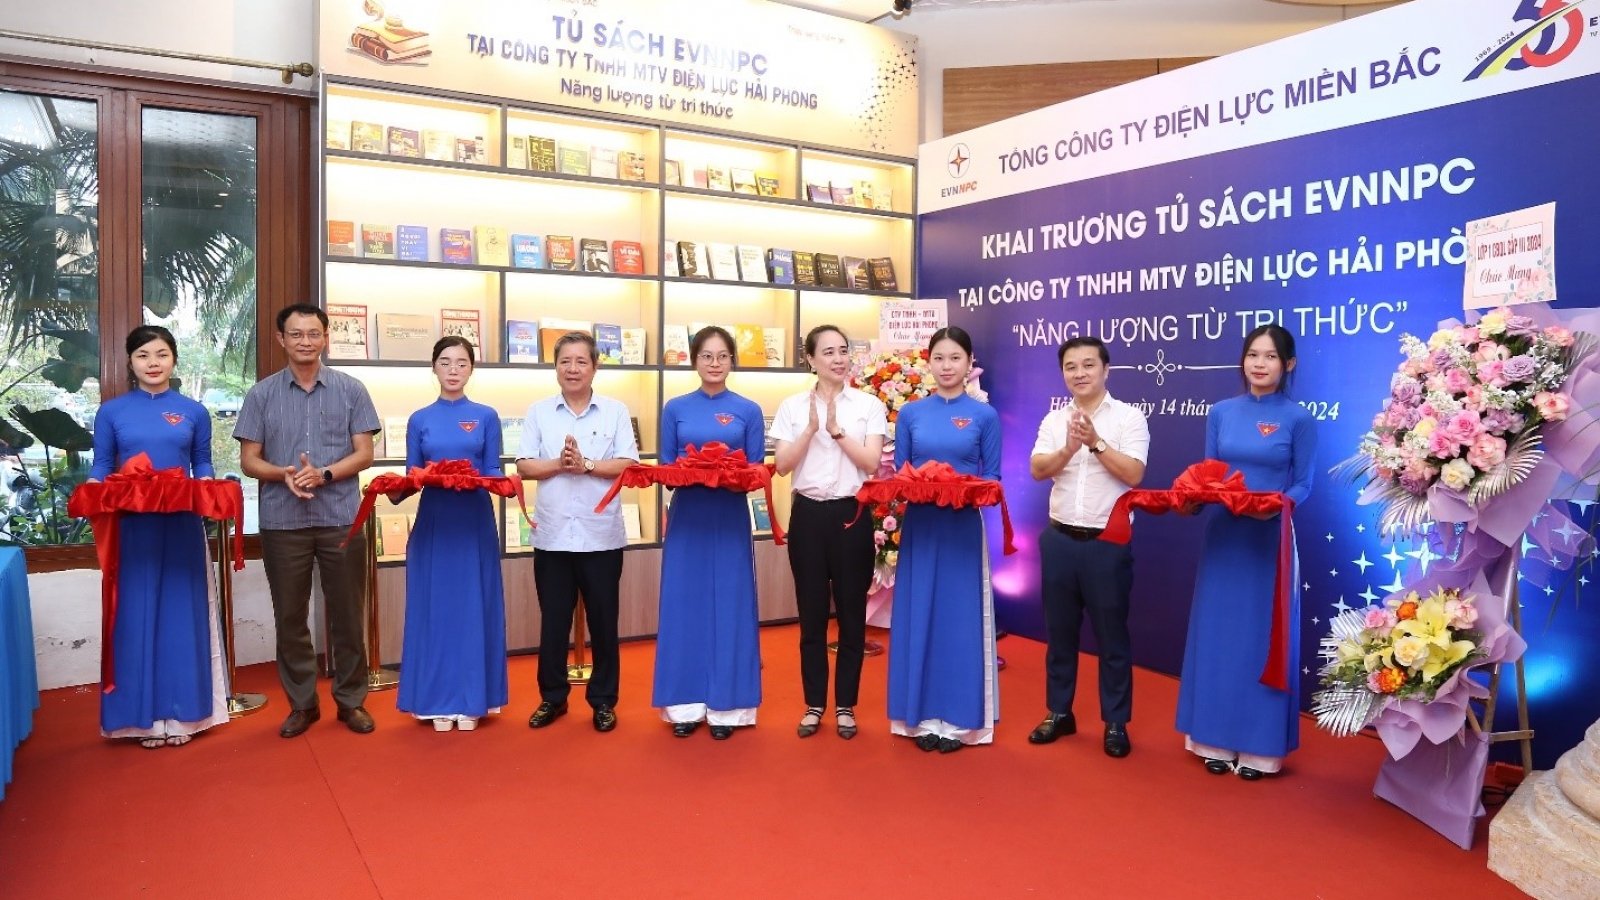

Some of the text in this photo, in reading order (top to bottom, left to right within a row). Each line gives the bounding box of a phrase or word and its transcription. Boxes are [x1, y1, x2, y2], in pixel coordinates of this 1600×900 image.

[552, 9, 768, 76] TỦ SÁCH EVNNPC
[1474, 46, 1492, 62] 1969
[1497, 30, 1515, 45] 2024
[467, 33, 494, 58] TẠI
[556, 48, 577, 69] TY
[633, 61, 667, 84] MTV
[673, 67, 706, 91] ĐIỆN
[745, 77, 768, 102] HẢI
[560, 77, 734, 118] Năng lượng từ tri thức
[998, 46, 1441, 174] TỔNG CÔNG TY ĐIỆN LỰC MIỀN BẮC
[941, 180, 978, 198] EVNNPC
[982, 157, 1476, 259] KHAI TRƯƠNG TỦ SÁCH EVNNPC
[1526, 234, 1542, 252] 2024
[959, 227, 1467, 311] TẠI CÔNG TY TNHH MTV ĐIỆN LỰC HẢI PHÒ
[1186, 306, 1227, 341] TỪ
[1159, 398, 1177, 415] 14
